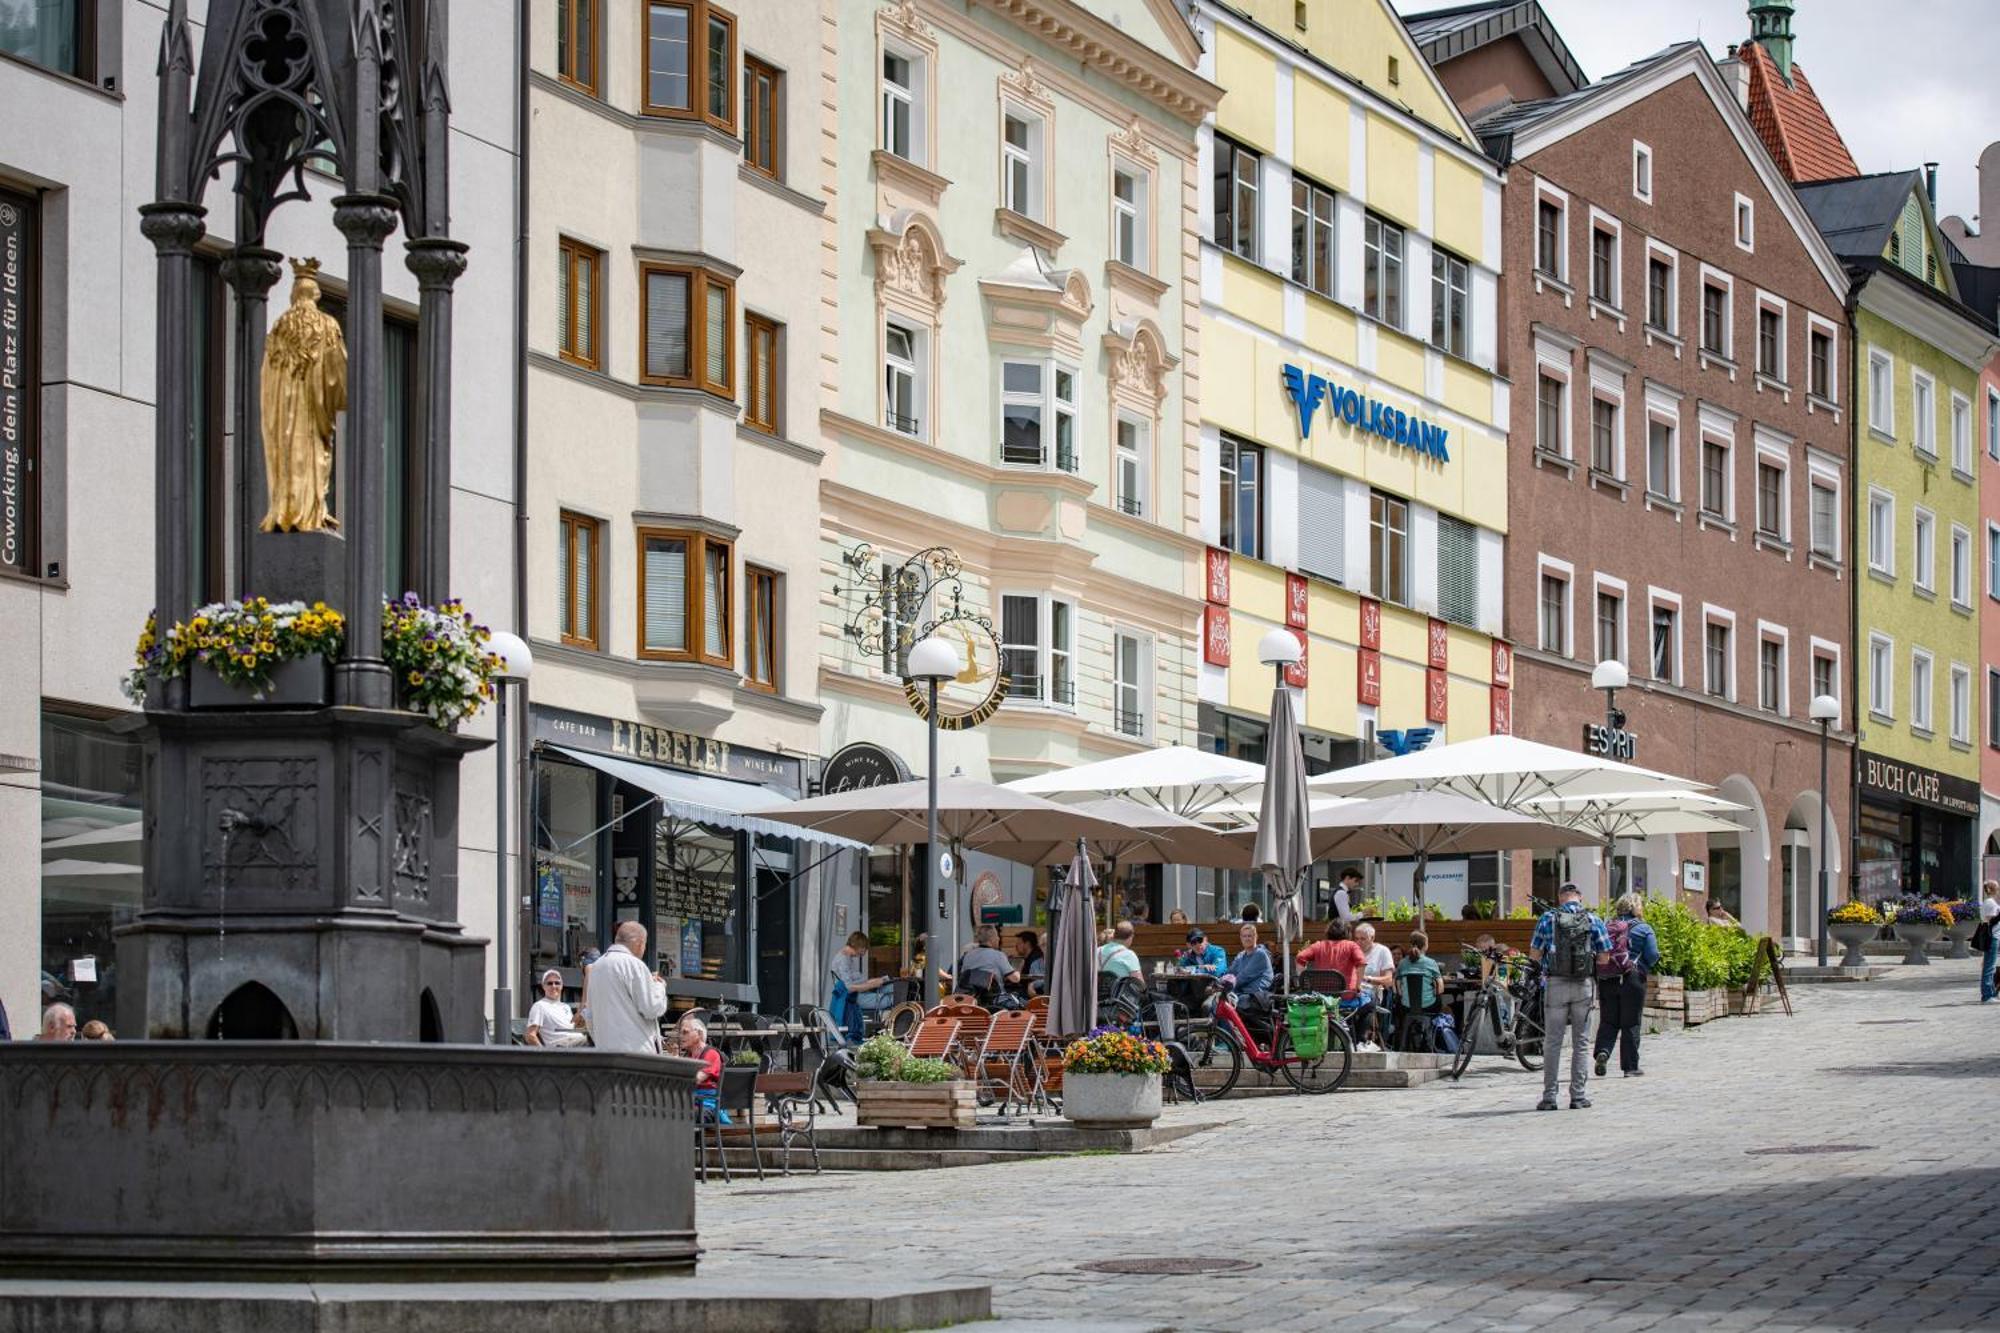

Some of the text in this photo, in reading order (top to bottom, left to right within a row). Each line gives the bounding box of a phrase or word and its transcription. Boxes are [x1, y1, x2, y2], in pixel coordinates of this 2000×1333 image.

[4, 231, 17, 294] Ideen.
[4, 298, 16, 330] für
[3, 334, 16, 389] Platz
[3, 395, 16, 441] dein
[1328, 382, 1450, 463] VOLKSBANK
[2, 448, 19, 565] Coworking,
[579, 724, 596, 737] BAR
[611, 718, 730, 773] LIEBELEI
[1590, 723, 1638, 761] ESPRIT
[744, 758, 784, 775] WINE BAR
[1867, 759, 1940, 802] BUCH CAFÉ
